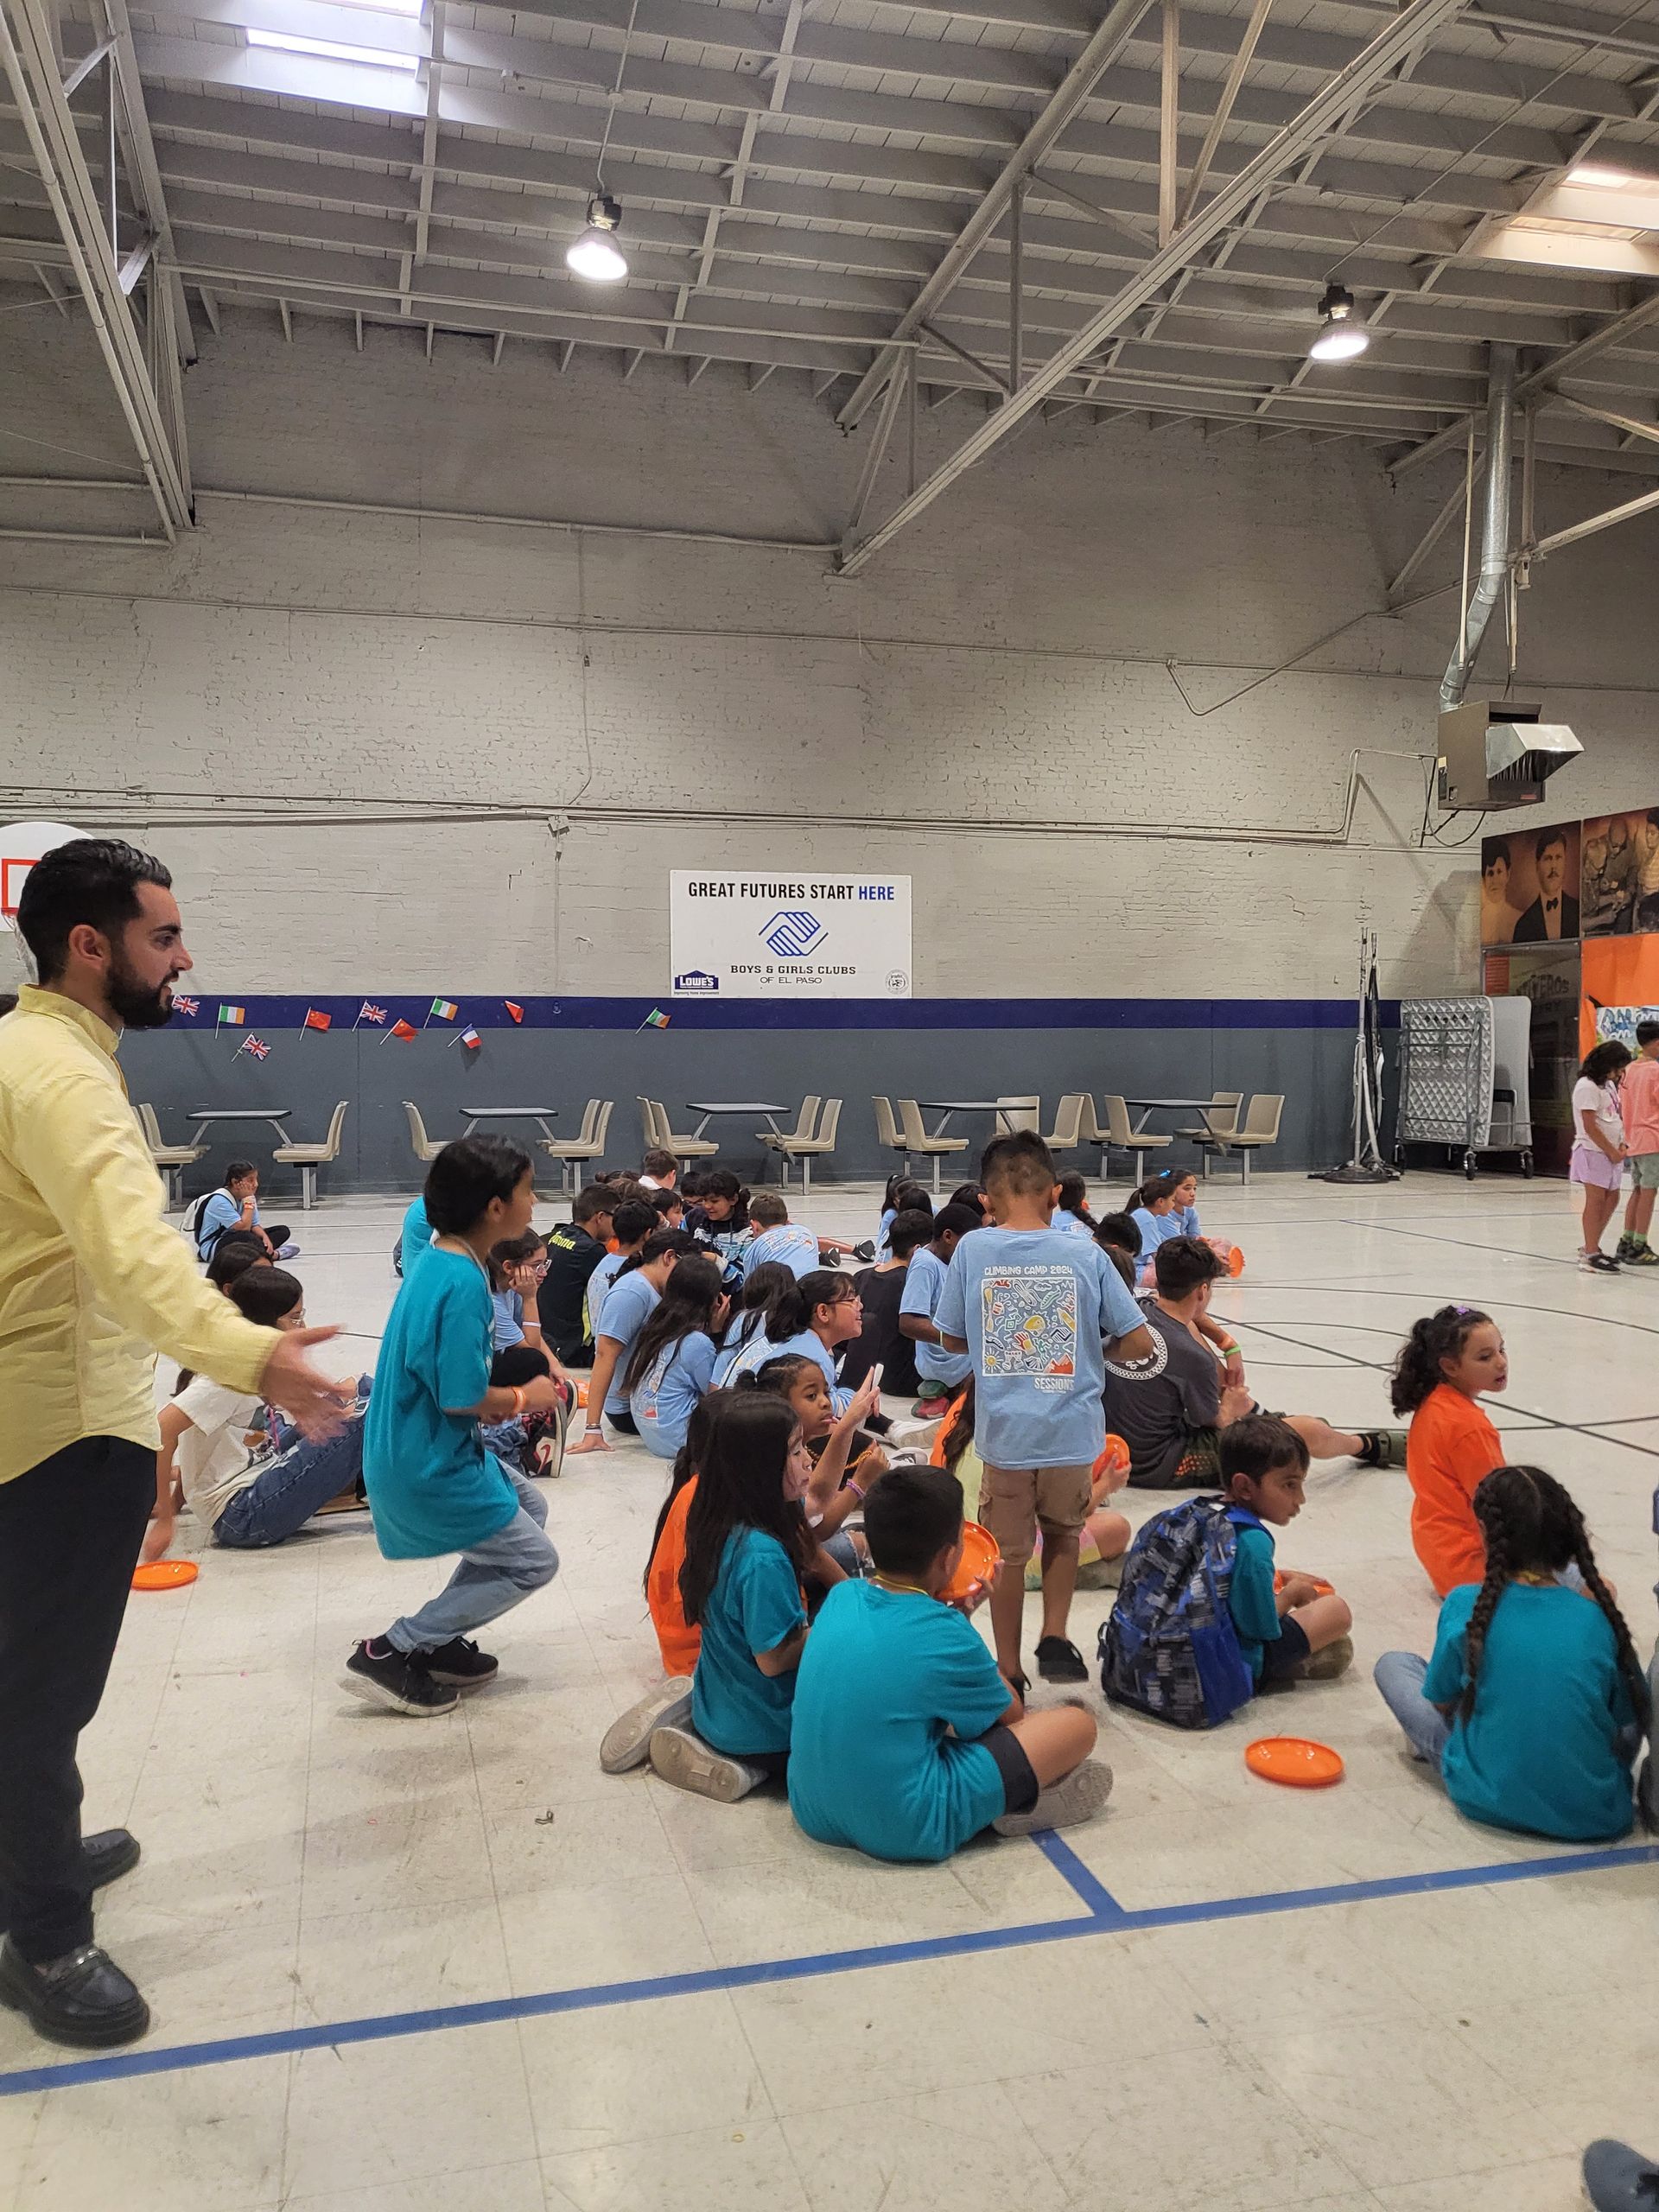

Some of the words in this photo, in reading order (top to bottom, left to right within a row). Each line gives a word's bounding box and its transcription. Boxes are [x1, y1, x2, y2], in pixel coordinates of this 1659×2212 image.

[689, 881, 736, 898] GREAT
[741, 883, 805, 899] FUTURES
[810, 884, 854, 899] START
[858, 886, 894, 900] HERE
[730, 964, 762, 974] BOYS
[766, 965, 774, 974] &
[778, 965, 814, 975] GIRLS
[817, 966, 856, 975] CLUBS
[984, 1265, 1021, 1276] CLIMBING
[1024, 1265, 1048, 1275] CAMP
[1050, 1265, 1073, 1274] 2024
[1033, 1377, 1075, 1391] SESSIONS
